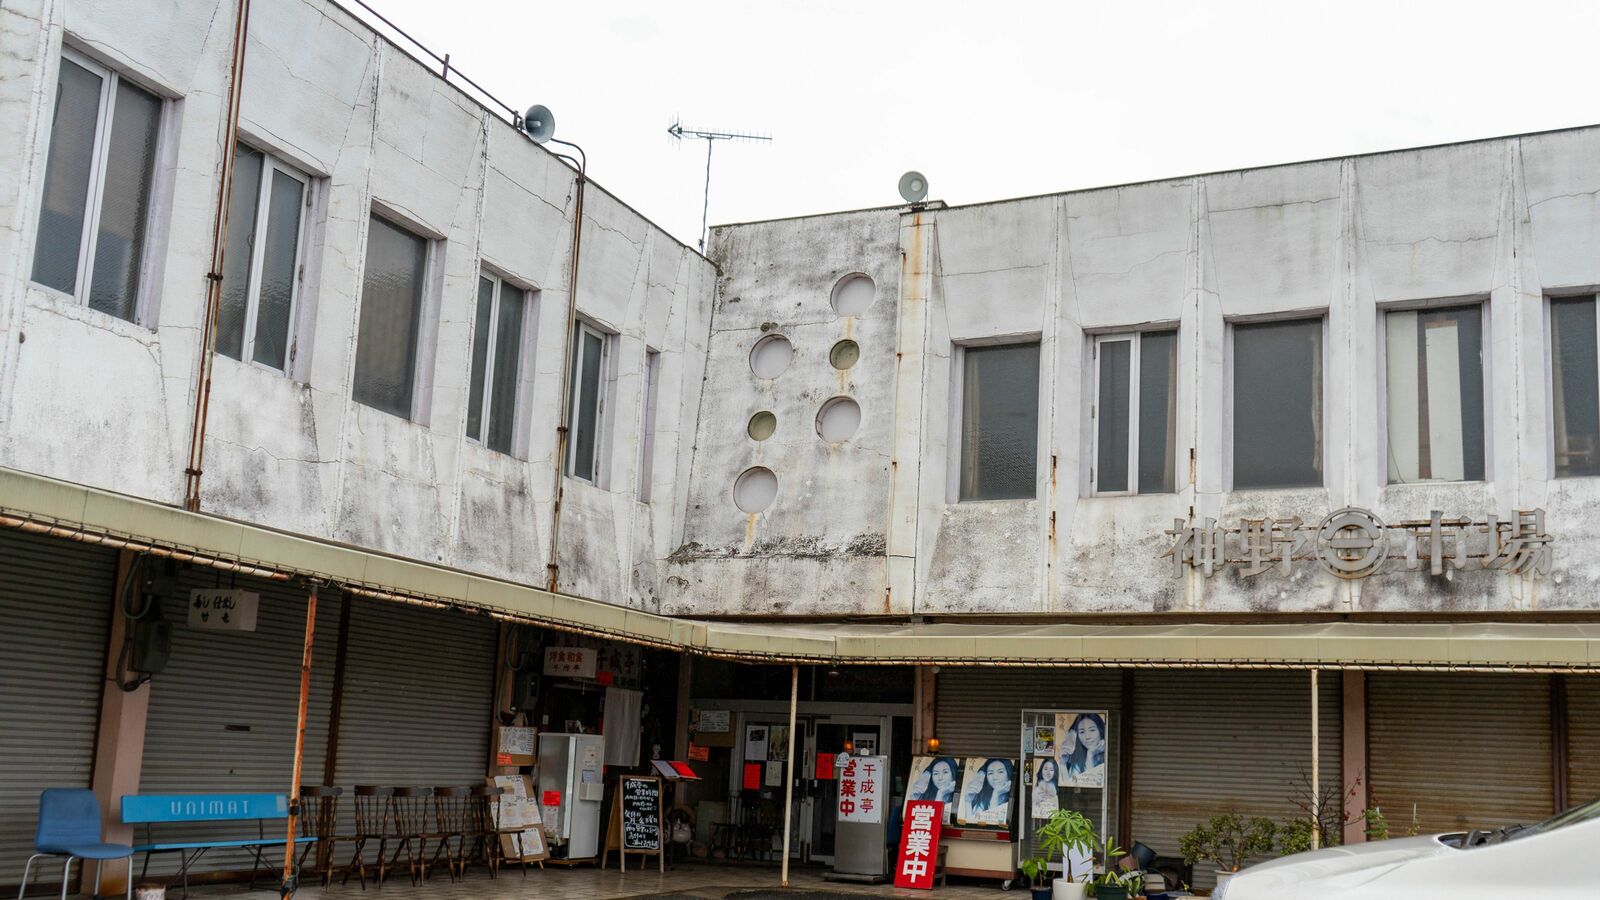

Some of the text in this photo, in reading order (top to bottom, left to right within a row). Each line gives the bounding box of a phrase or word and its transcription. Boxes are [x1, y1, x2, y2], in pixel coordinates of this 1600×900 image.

[171, 800, 249, 815] UNIMAT
[839, 759, 857, 816] 営業中
[860, 764, 876, 813] 千成亭
[902, 804, 935, 883] 営業中
